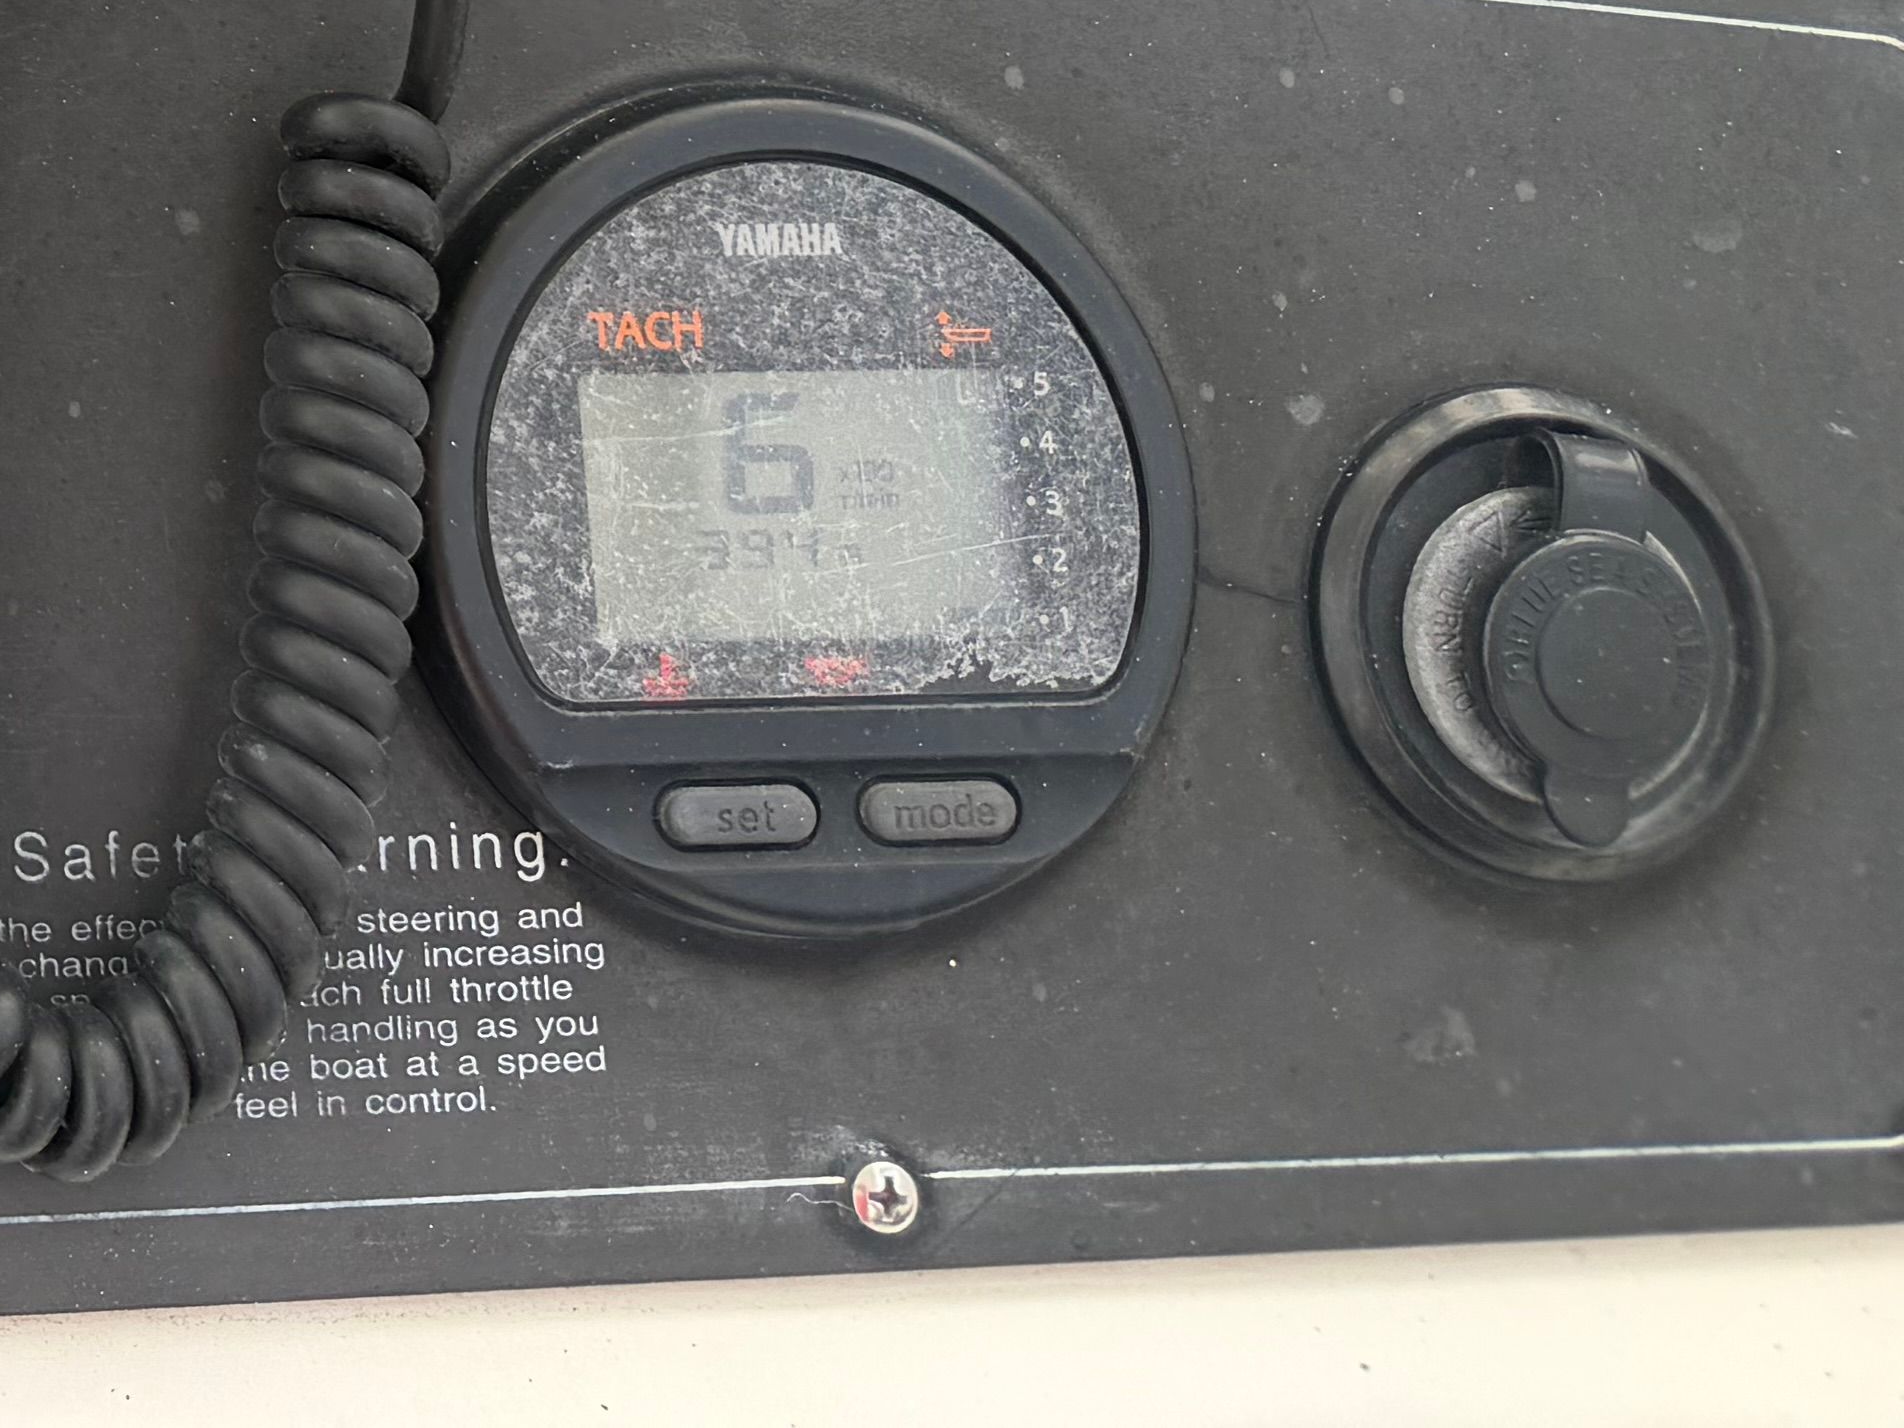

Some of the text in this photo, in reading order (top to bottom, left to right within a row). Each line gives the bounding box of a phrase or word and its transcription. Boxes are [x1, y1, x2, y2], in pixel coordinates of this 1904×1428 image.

[716, 222, 843, 257] YAMAHA
[589, 311, 703, 350] TACH
[726, 391, 814, 516] 6
[716, 792, 997, 834] set mode
[14, 831, 188, 883] Safet
[357, 905, 499, 937] steering
[518, 902, 583, 929] and
[424, 938, 605, 970] increasing
[381, 974, 573, 1004] full throttle
[307, 1014, 598, 1047] handling as you
[311, 1046, 606, 1080] boat at a speed
[234, 1086, 496, 1118] feel in control.
